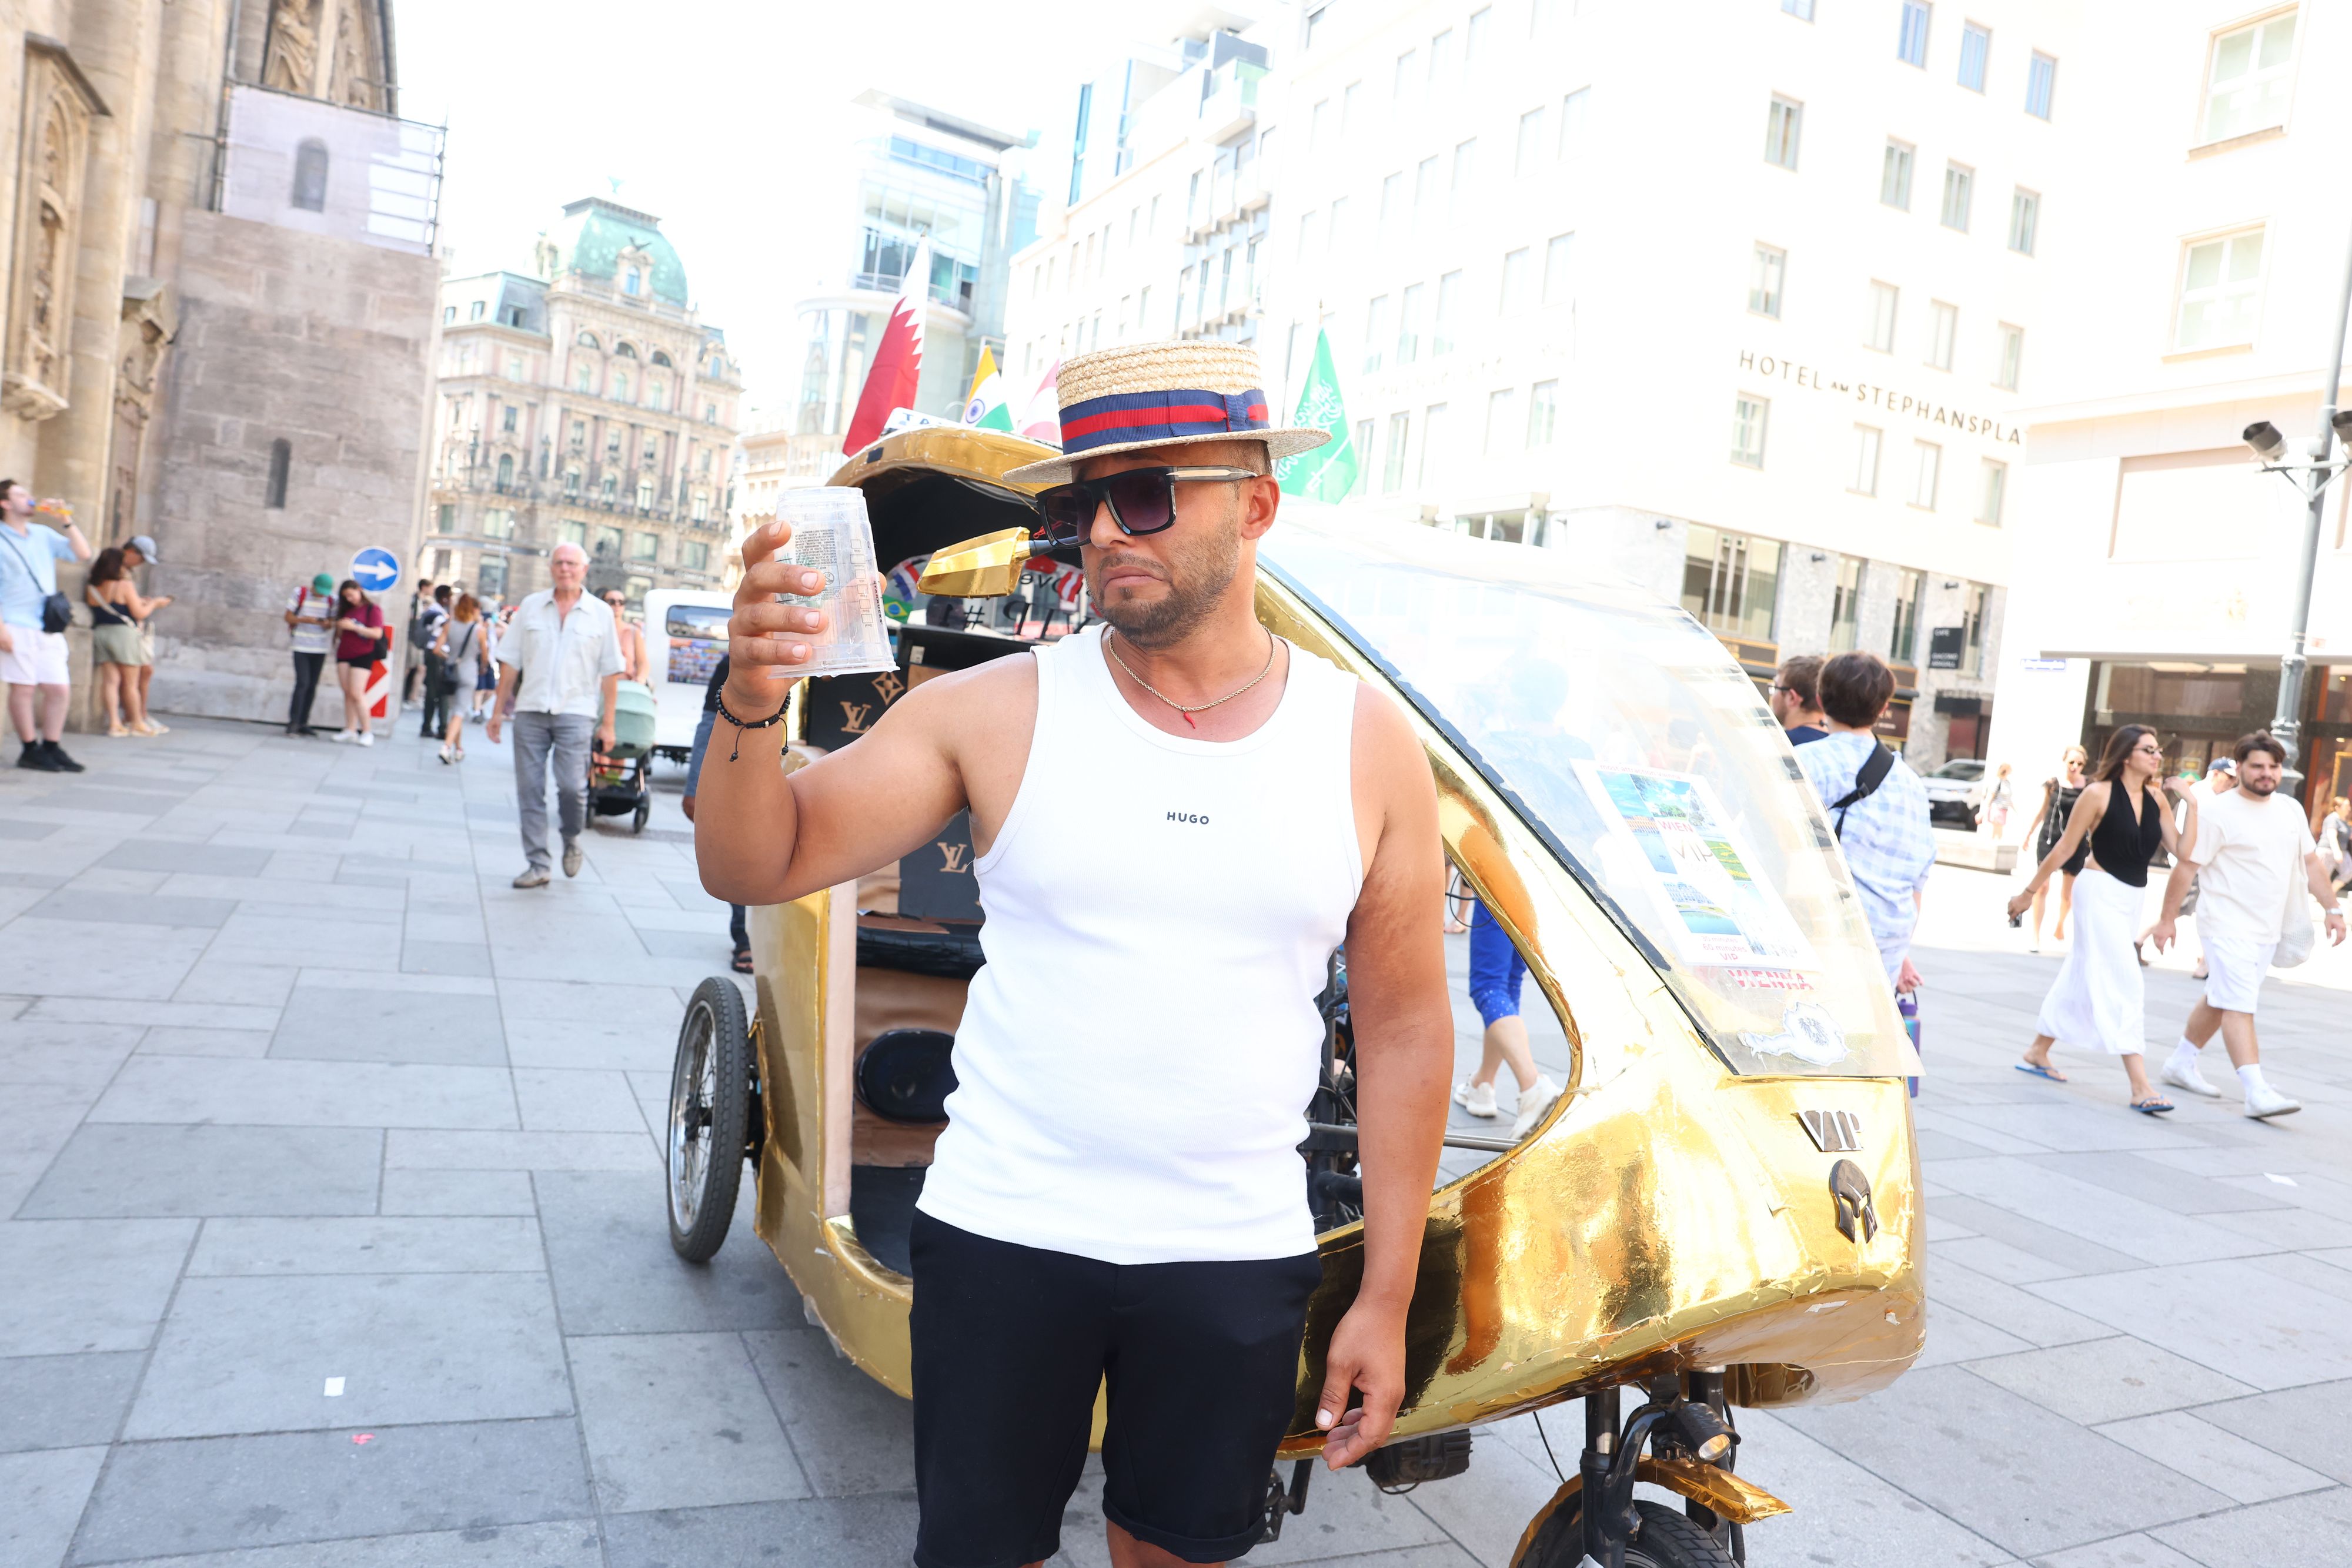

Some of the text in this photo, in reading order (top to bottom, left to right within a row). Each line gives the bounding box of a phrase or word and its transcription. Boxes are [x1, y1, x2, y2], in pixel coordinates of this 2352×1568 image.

[1739, 349, 1822, 390] HOTEL
[1830, 381, 1849, 393] AM
[1167, 811, 1209, 825] HUGO
[1658, 820, 1695, 833] WIEN
[937, 842, 968, 874] LV
[1719, 952, 1739, 961] VIP
[1726, 969, 1815, 991] VIENNA
[1790, 1109, 1864, 1153] VIP
